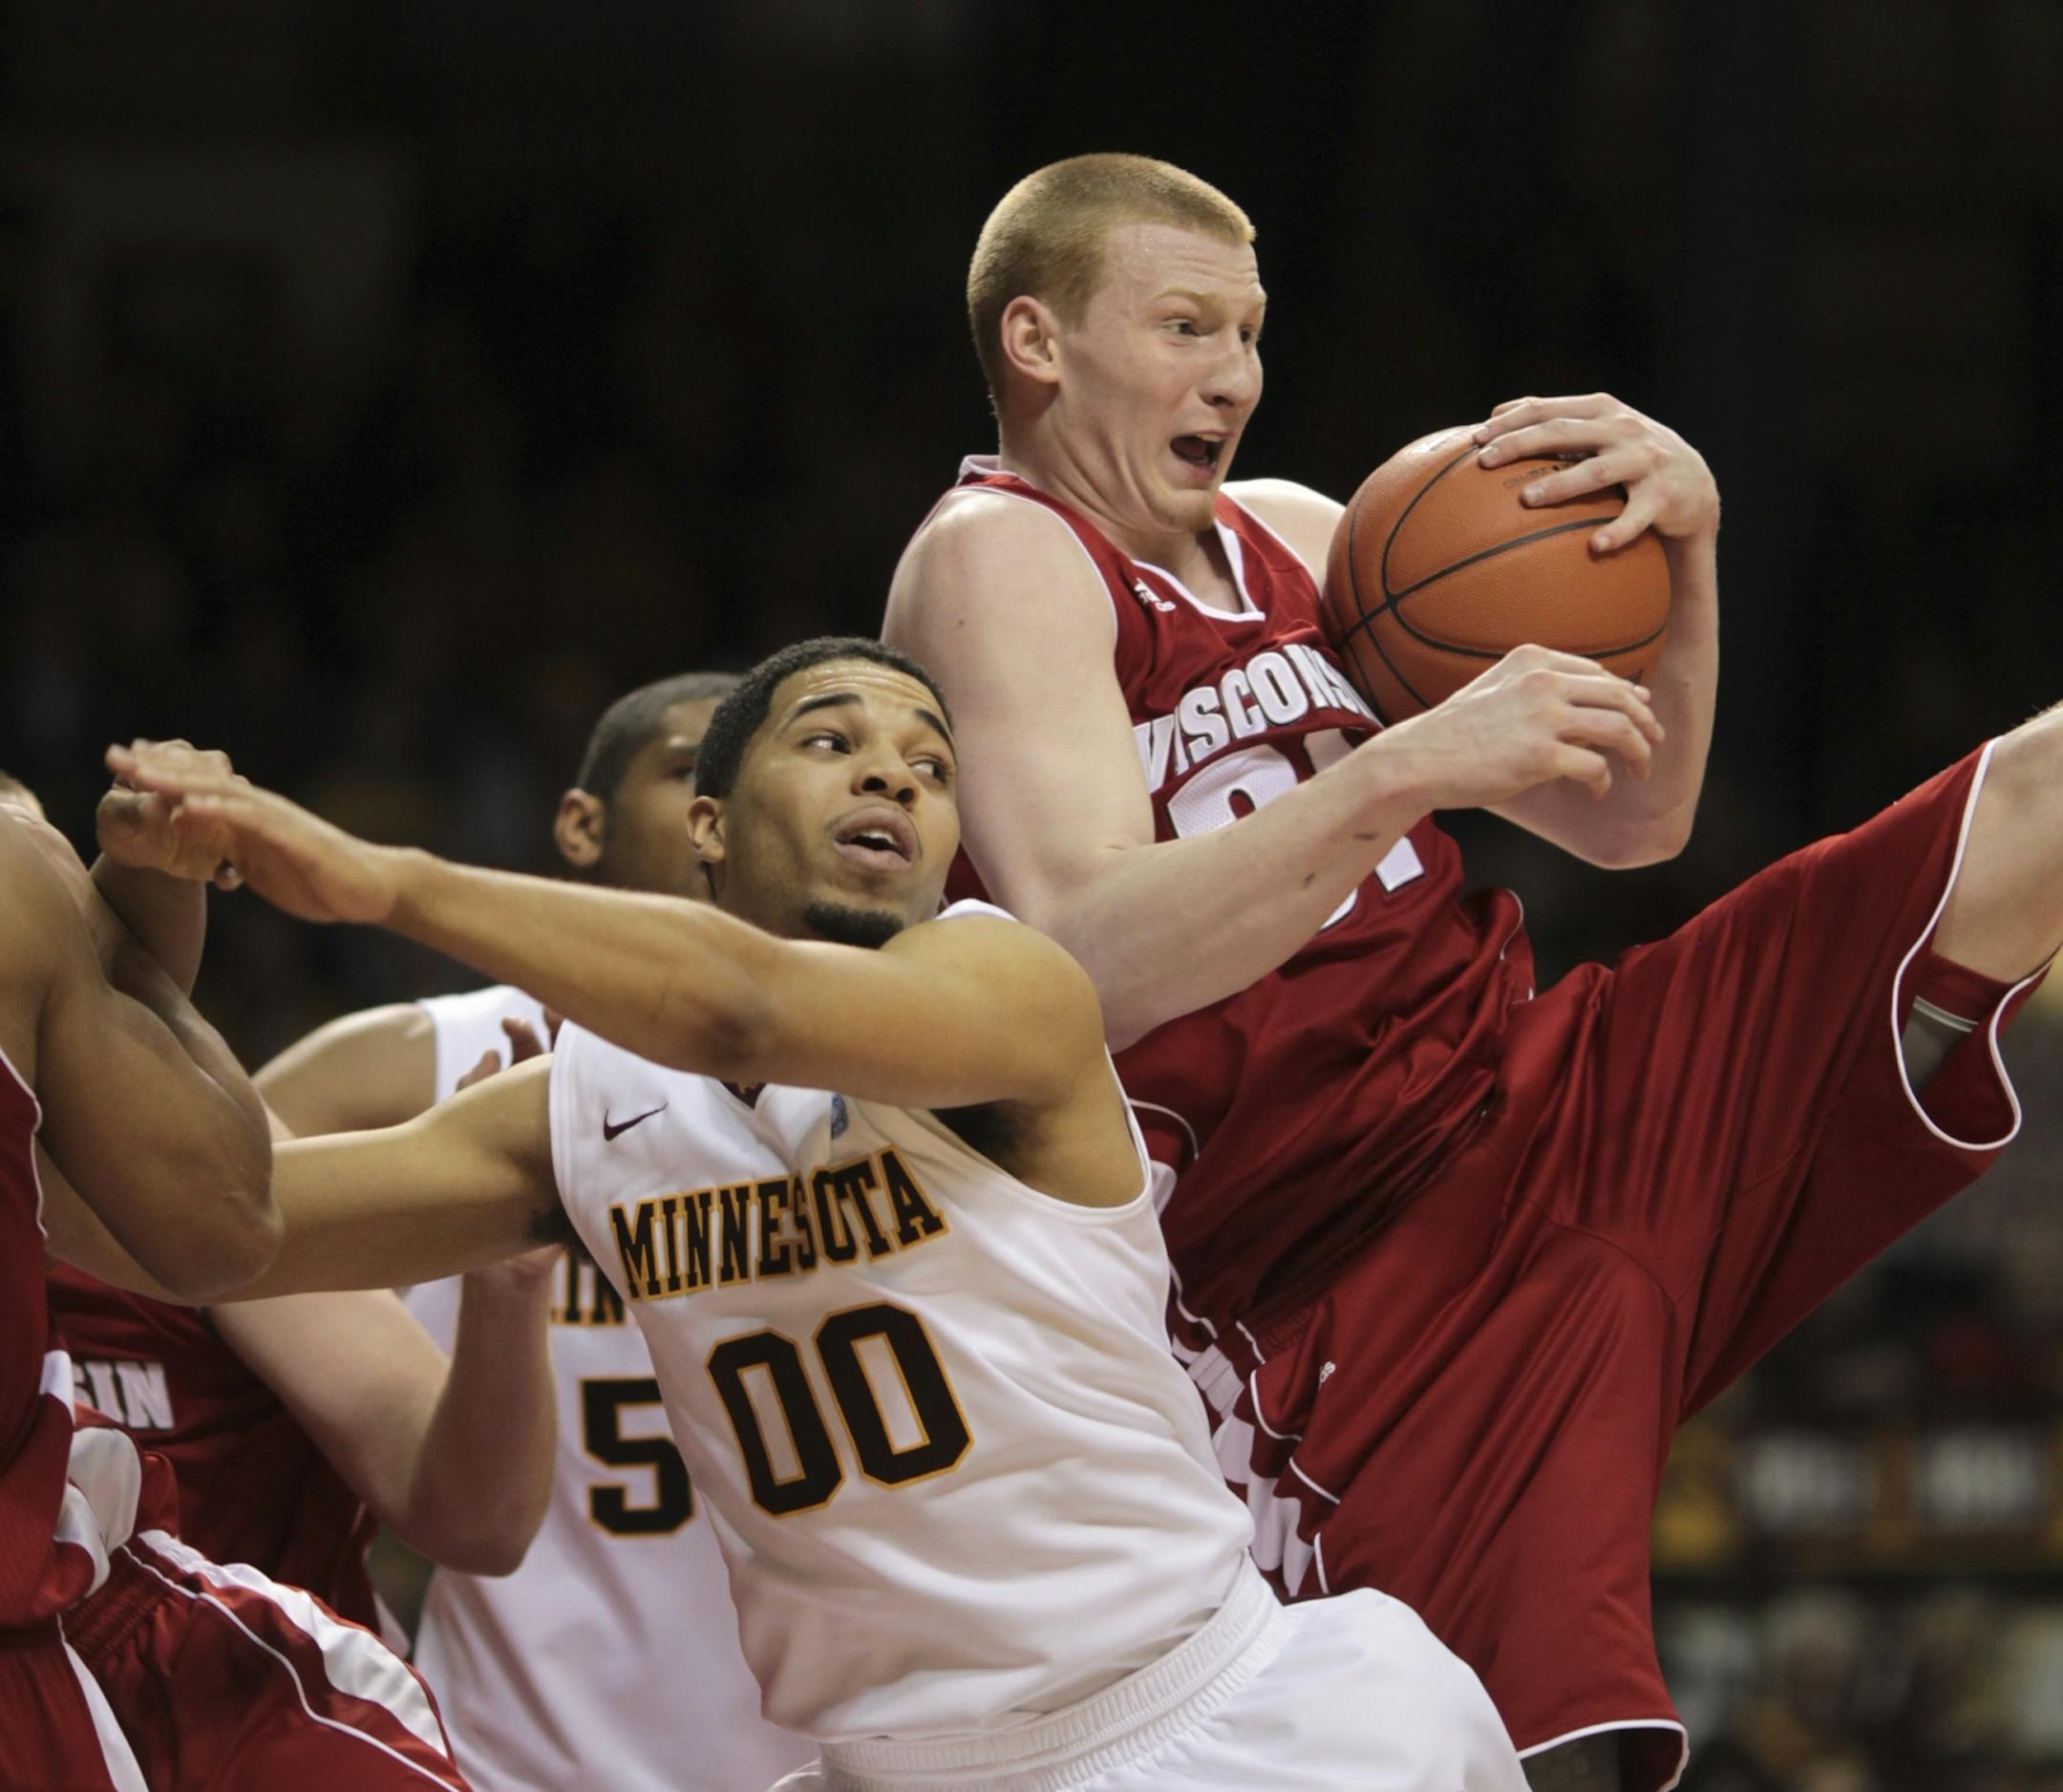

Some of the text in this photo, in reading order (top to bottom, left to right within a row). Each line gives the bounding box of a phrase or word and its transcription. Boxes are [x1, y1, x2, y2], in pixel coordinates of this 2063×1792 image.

[609, 1147, 946, 1303] MINNESOTA
[578, 1376, 697, 1540] 5
[707, 1301, 975, 1518] 00
